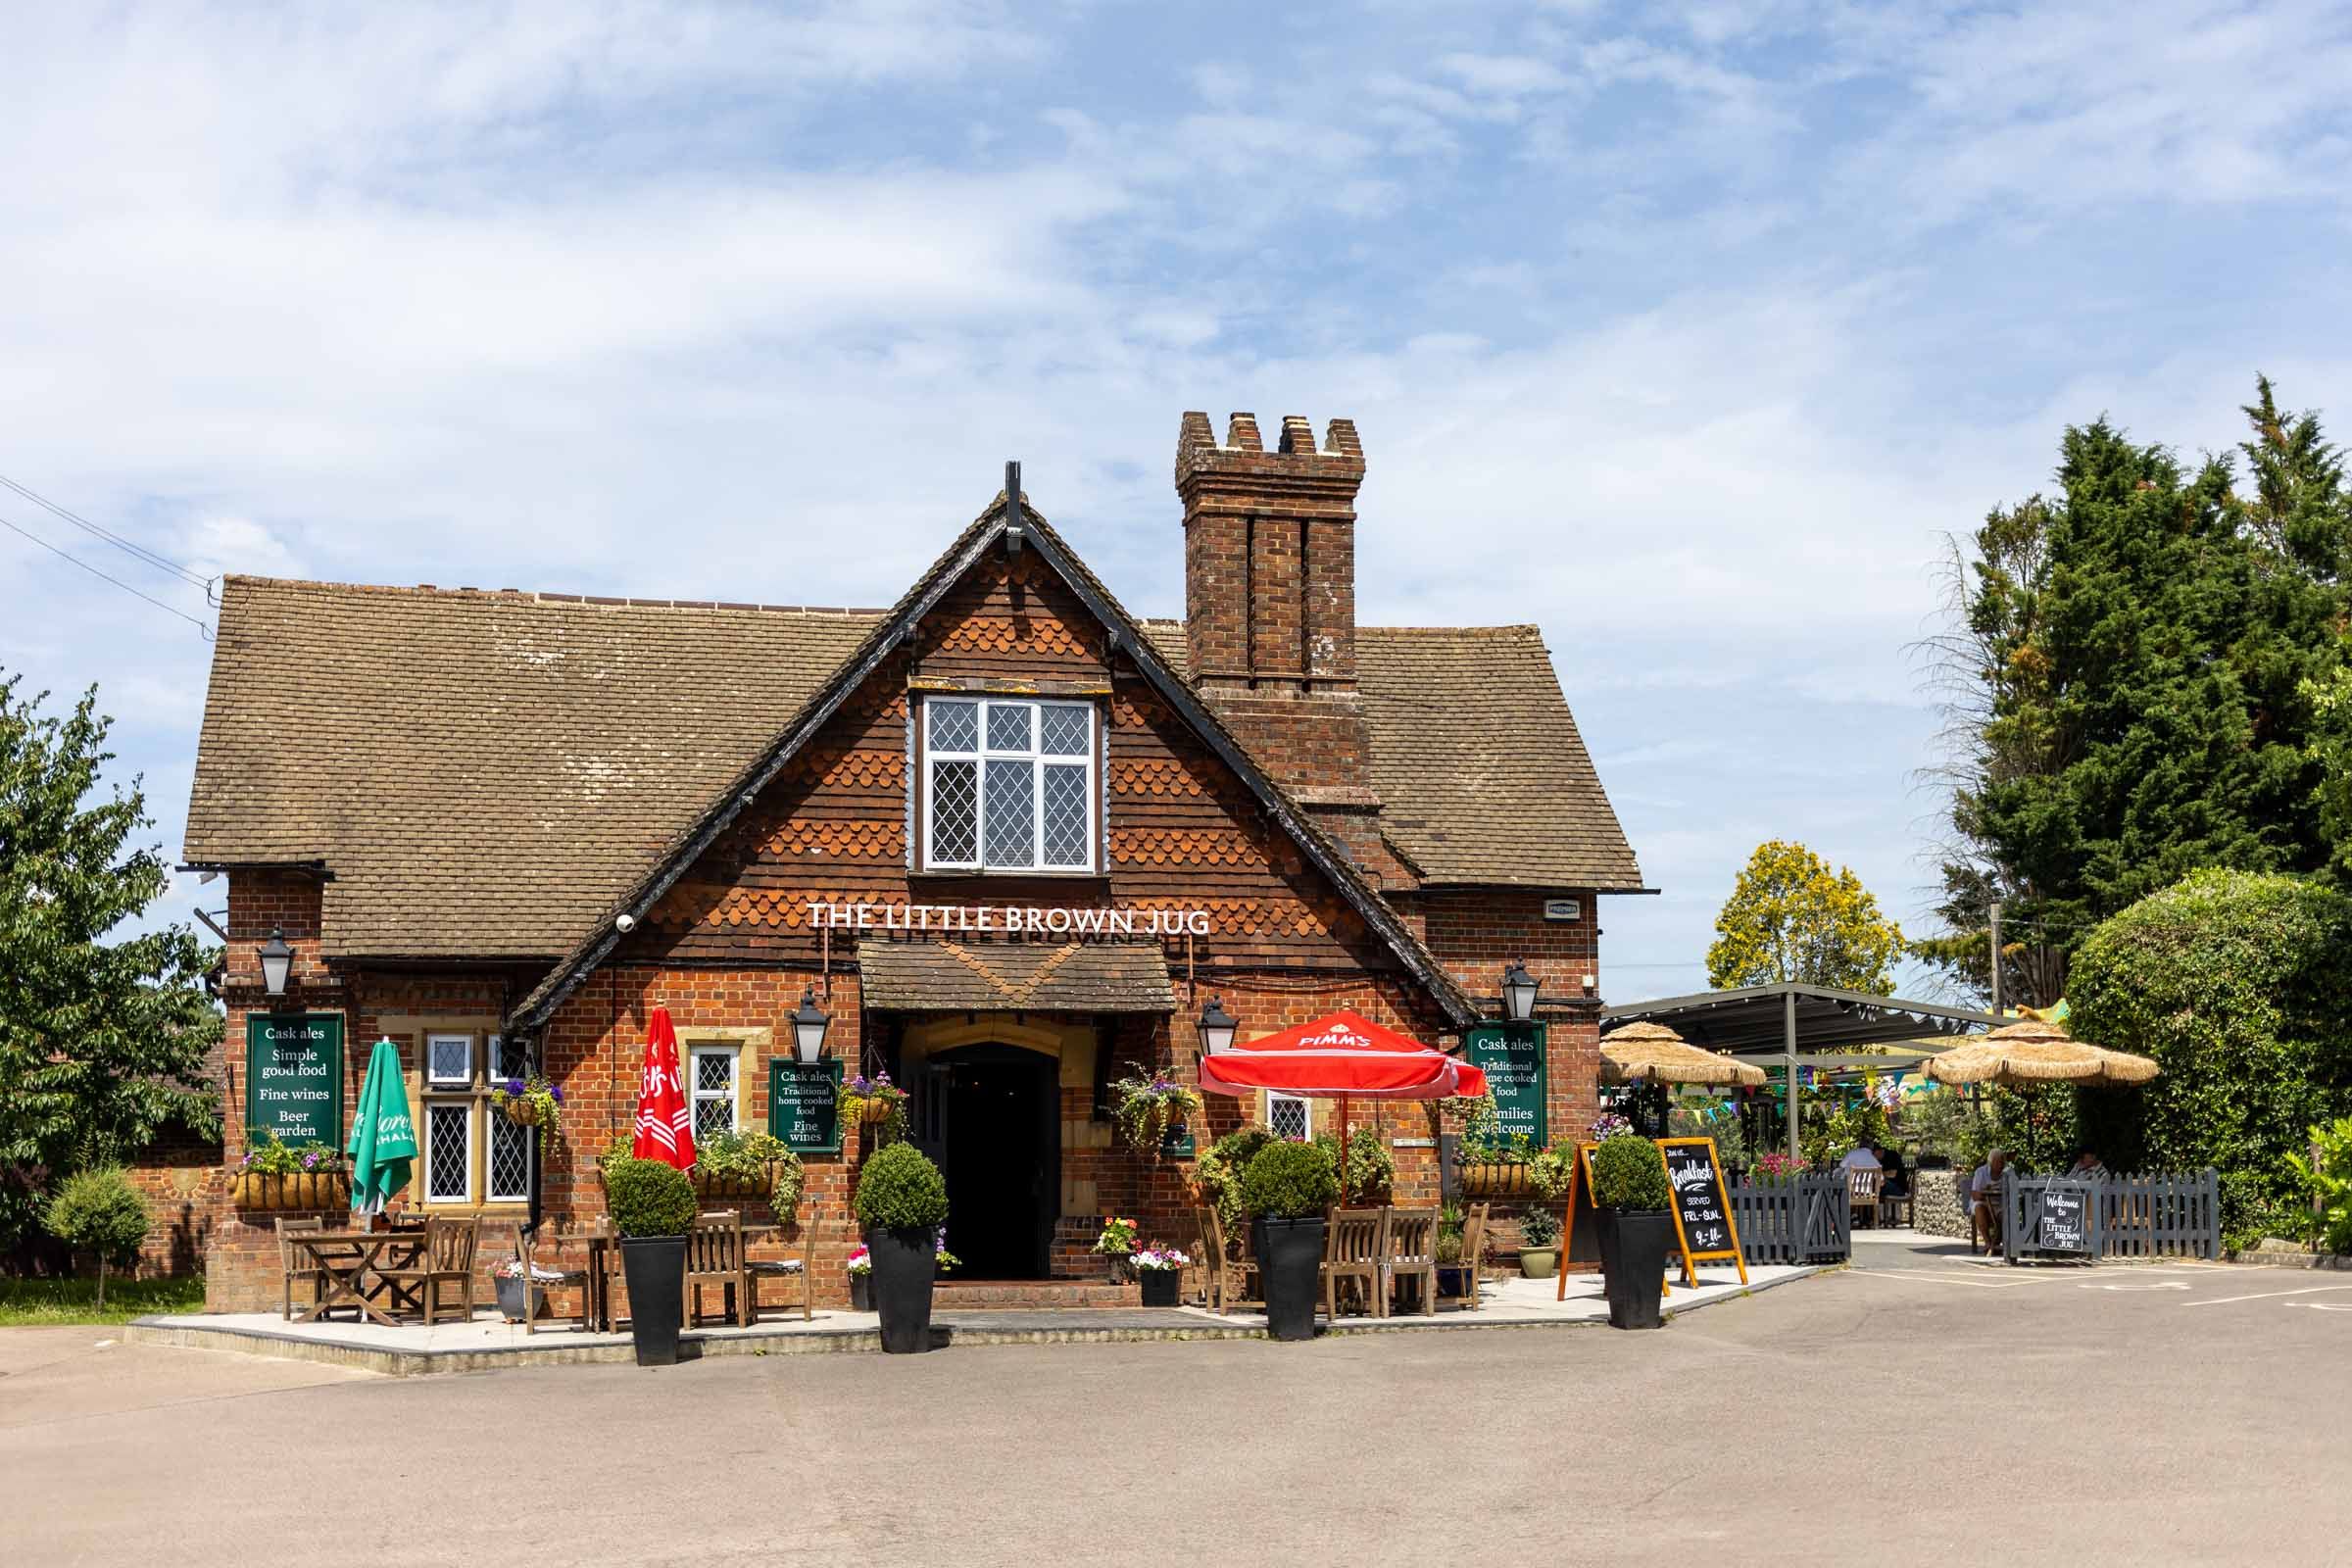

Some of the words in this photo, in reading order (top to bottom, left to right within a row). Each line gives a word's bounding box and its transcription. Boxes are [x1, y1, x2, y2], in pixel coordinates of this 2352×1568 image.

[807, 903, 873, 928] THE
[886, 905, 992, 932] LITTLE
[1005, 907, 1133, 934] BROWN
[1144, 909, 1208, 935] JUG
[266, 1027, 296, 1040] Cask
[300, 1027, 324, 1040] ales
[1478, 1038, 1508, 1051] Cask
[1510, 1038, 1534, 1051] ales
[272, 1048, 318, 1063] Simple
[262, 1063, 294, 1079] good
[298, 1063, 326, 1076] food
[1481, 1060, 1532, 1071] Traditional
[781, 1070, 808, 1082] Cask
[809, 1070, 832, 1082] ales
[1504, 1072, 1537, 1083] cooked
[260, 1088, 288, 1100] Fine
[291, 1088, 329, 1100] wines
[782, 1087, 829, 1096] Traditional
[1496, 1086, 1517, 1097] food
[778, 1096, 802, 1104] home
[804, 1096, 833, 1104] cooked
[796, 1105, 815, 1115] food
[1482, 1106, 1534, 1119] Fmilies
[278, 1110, 310, 1122] Beer
[271, 1124, 317, 1138] garden
[794, 1120, 818, 1131] Fine
[790, 1131, 822, 1142] wines
[1669, 1159, 1713, 1192] Breakfast
[1687, 1197, 1711, 1205] SERVED
[2046, 1195, 2080, 1208] Welcome
[2058, 1206, 2067, 1216] to
[2046, 1223, 2072, 1233] LITTLE
[2054, 1231, 2081, 1242] BROWN
